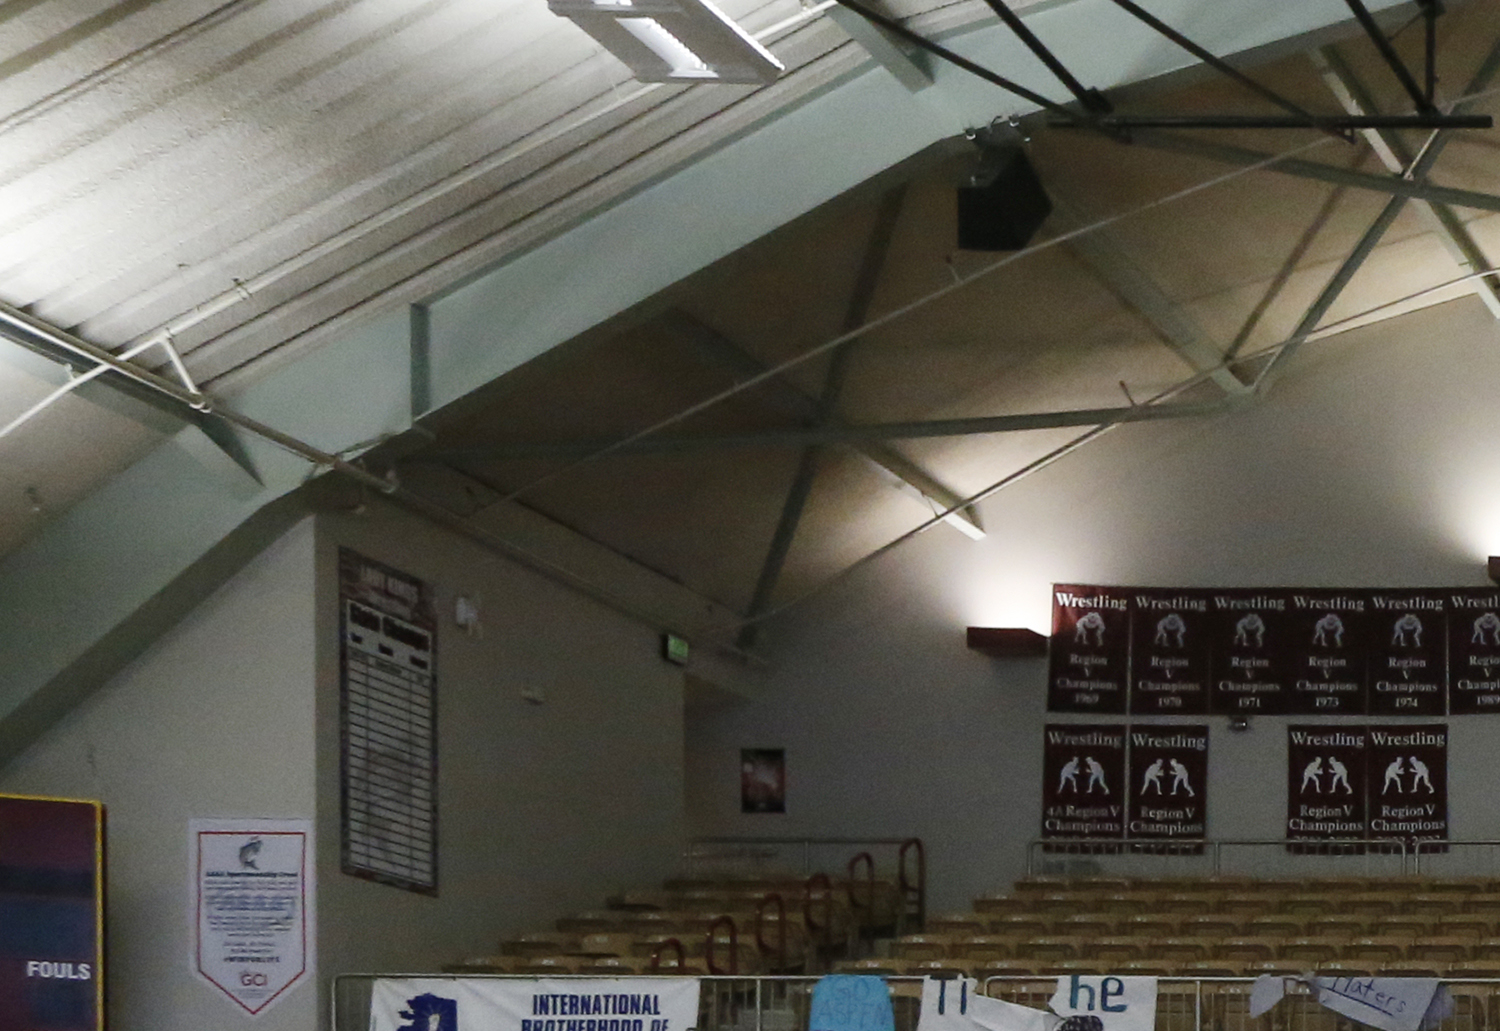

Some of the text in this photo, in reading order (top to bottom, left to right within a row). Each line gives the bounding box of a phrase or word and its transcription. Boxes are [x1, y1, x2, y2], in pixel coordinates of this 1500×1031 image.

[1055, 592, 1128, 611] Wrestling
[1291, 732, 1364, 748] Wrestling
[1371, 732, 1445, 747] Wrestling
[1300, 805, 1342, 819] Region
[1382, 805, 1424, 819] Region
[1289, 818, 1363, 833] Champions
[1371, 818, 1445, 833] Champions
[27, 960, 91, 980] FOULS
[532, 994, 660, 1015] INTERNATIONAL
